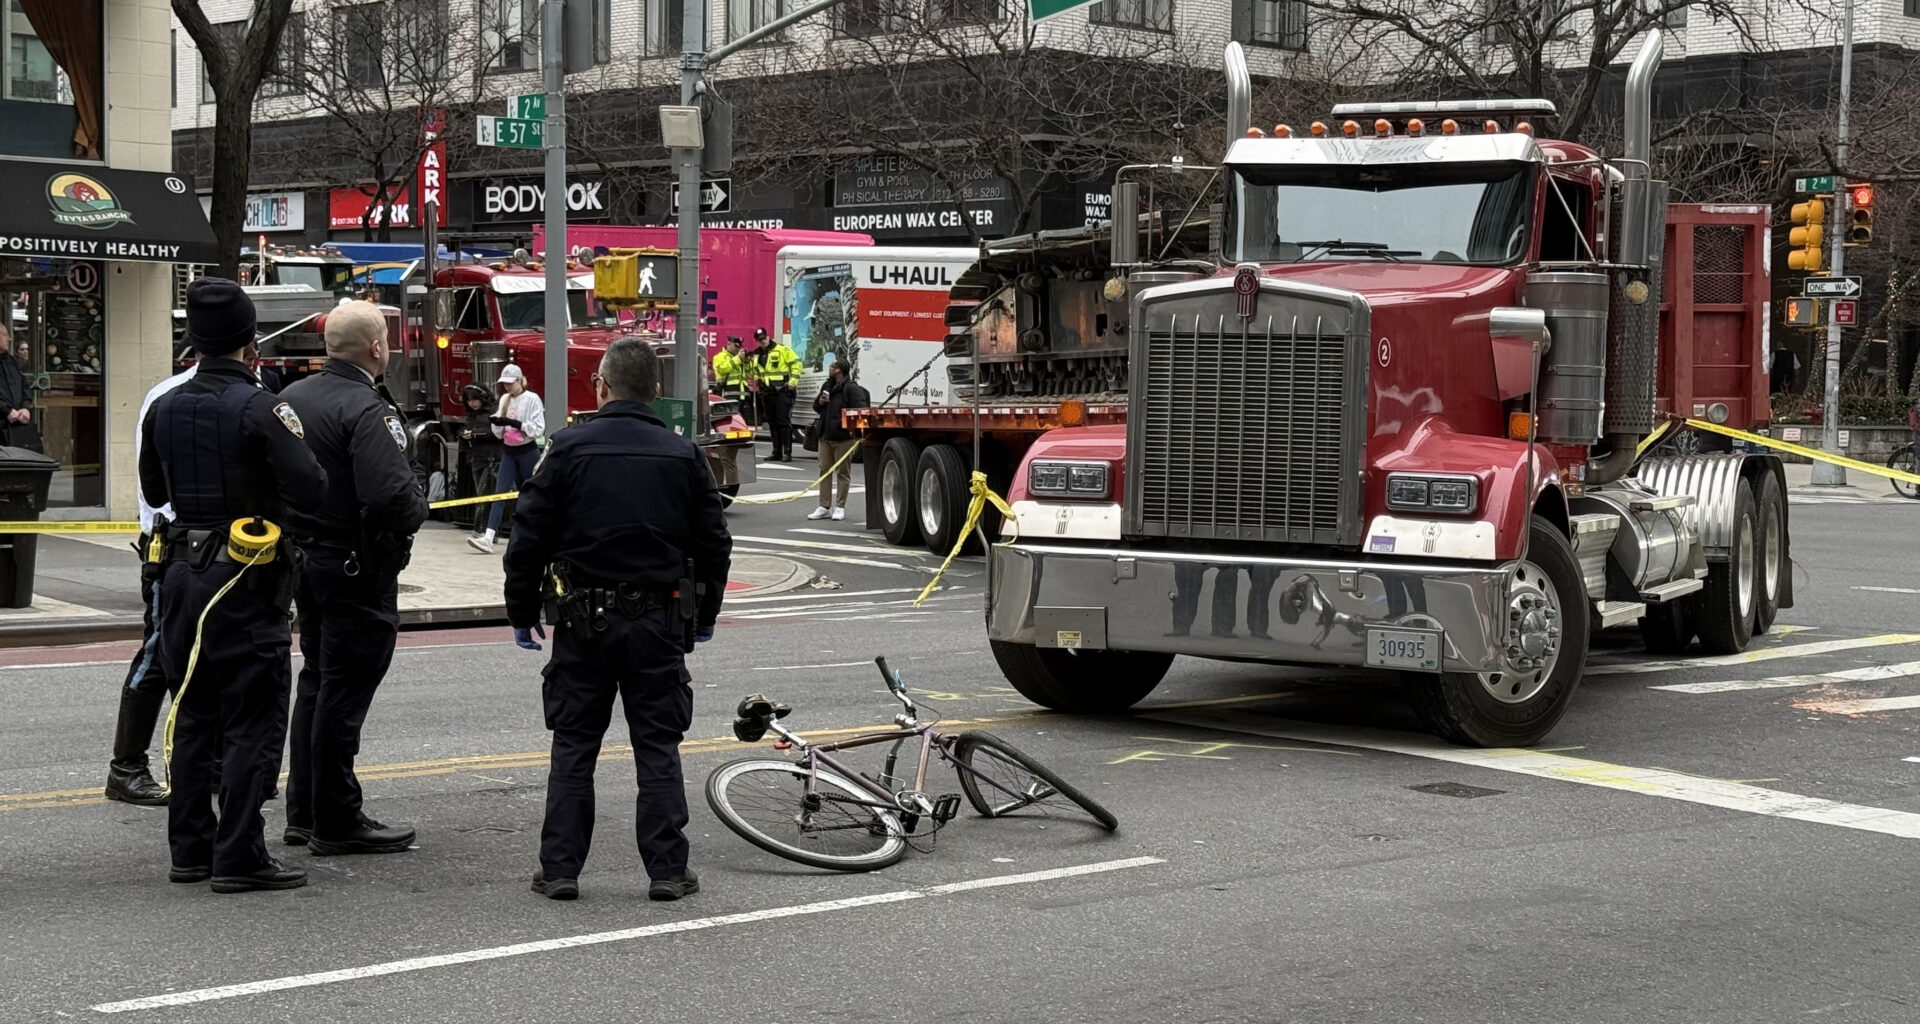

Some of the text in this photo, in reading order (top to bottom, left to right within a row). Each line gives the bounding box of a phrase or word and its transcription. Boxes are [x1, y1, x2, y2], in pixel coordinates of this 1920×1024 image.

[524, 96, 540, 118] 2 Av
[496, 121, 540, 144] E 57 St
[856, 175, 911, 187] GYM & POOL
[1812, 178, 1818, 190] 2
[485, 182, 603, 213] BODYOK
[701, 190, 719, 203] WAY
[842, 191, 882, 203] PHSICAL
[1085, 193, 1112, 206] EURO
[1085, 205, 1107, 218] WAX
[833, 213, 902, 231] EUROPEAN
[906, 211, 936, 228] WAX
[0, 236, 180, 258] POSITIVELY HEALTHY
[1809, 283, 1852, 292] ONE WAY
[1381, 344, 1388, 361] 2
[930, 387, 944, 398] Van
[1379, 639, 1425, 659] 30935
